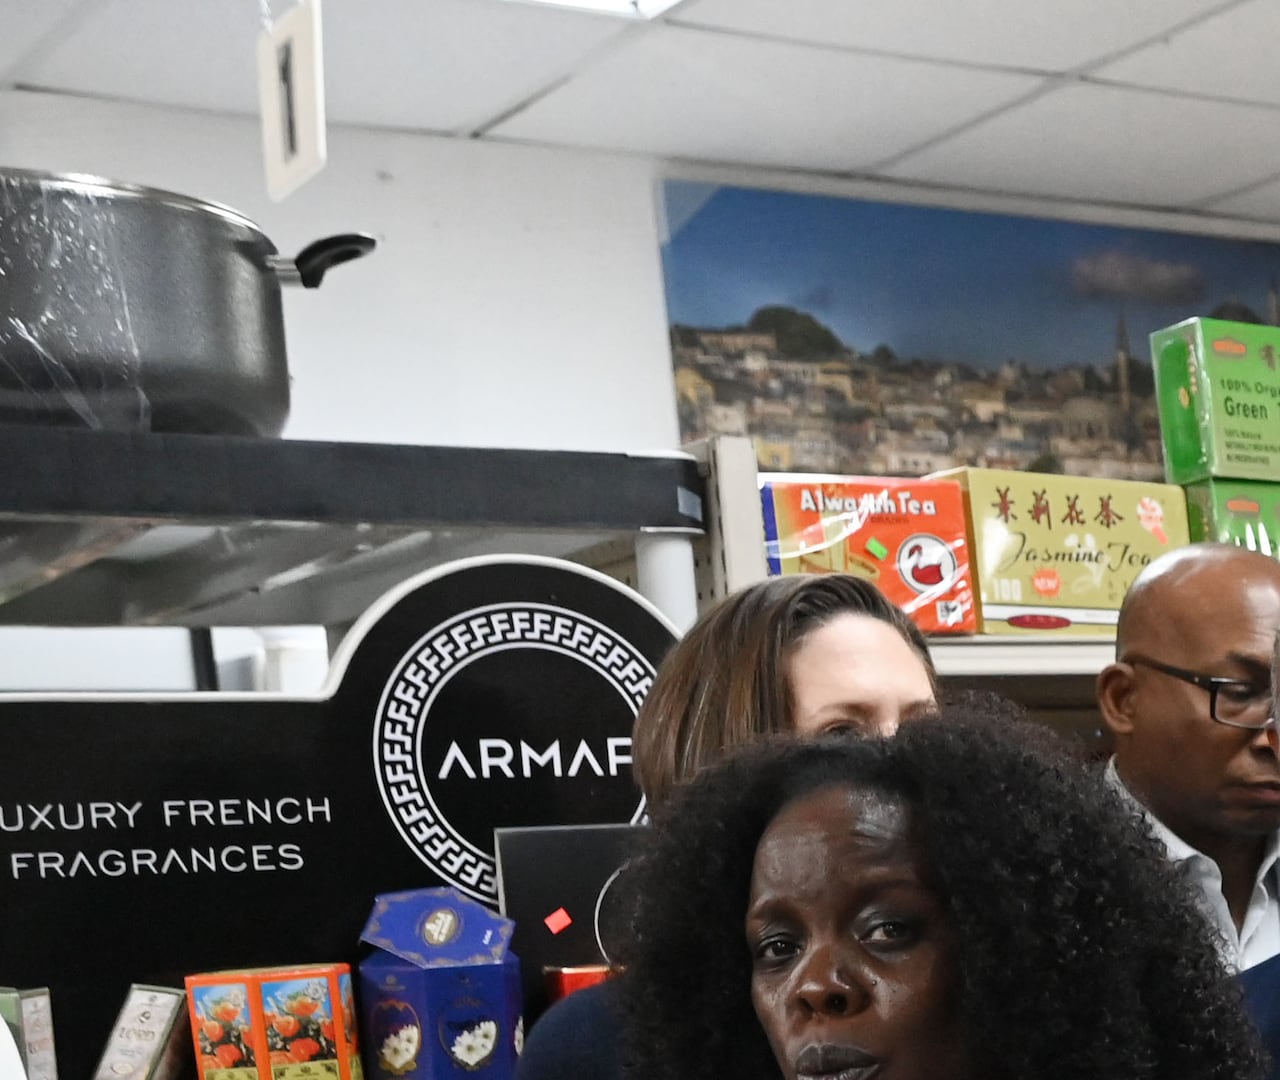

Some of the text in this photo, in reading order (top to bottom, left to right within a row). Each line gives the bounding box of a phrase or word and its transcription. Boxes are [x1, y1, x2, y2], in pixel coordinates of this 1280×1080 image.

[1224, 396, 1268, 420] Green
[801, 489, 937, 516] Alwah Tea
[998, 531, 1153, 573] Jasmine Tea
[163, 797, 331, 826] FRENCH
[11, 844, 304, 879] FRAGRANCES
